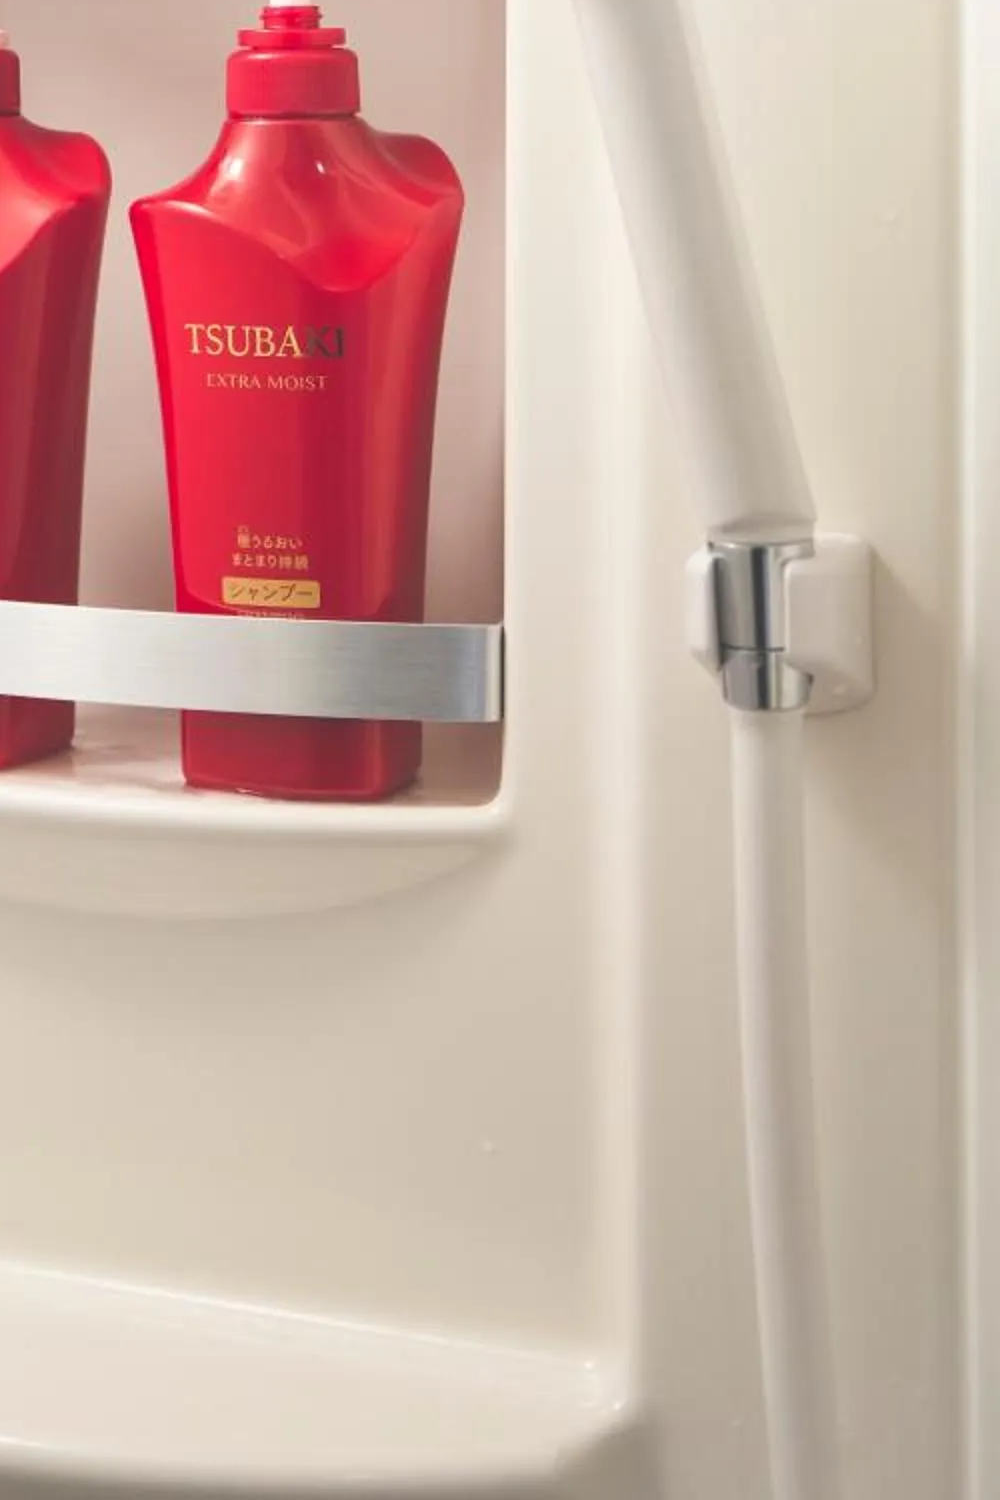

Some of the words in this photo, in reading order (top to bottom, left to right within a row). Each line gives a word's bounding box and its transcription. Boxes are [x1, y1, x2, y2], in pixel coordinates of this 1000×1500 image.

[184, 323, 344, 358] TSUBAKI
[206, 373, 261, 389] EXTRA
[267, 374, 328, 391] MOIST
[229, 583, 313, 602] シャンプー
